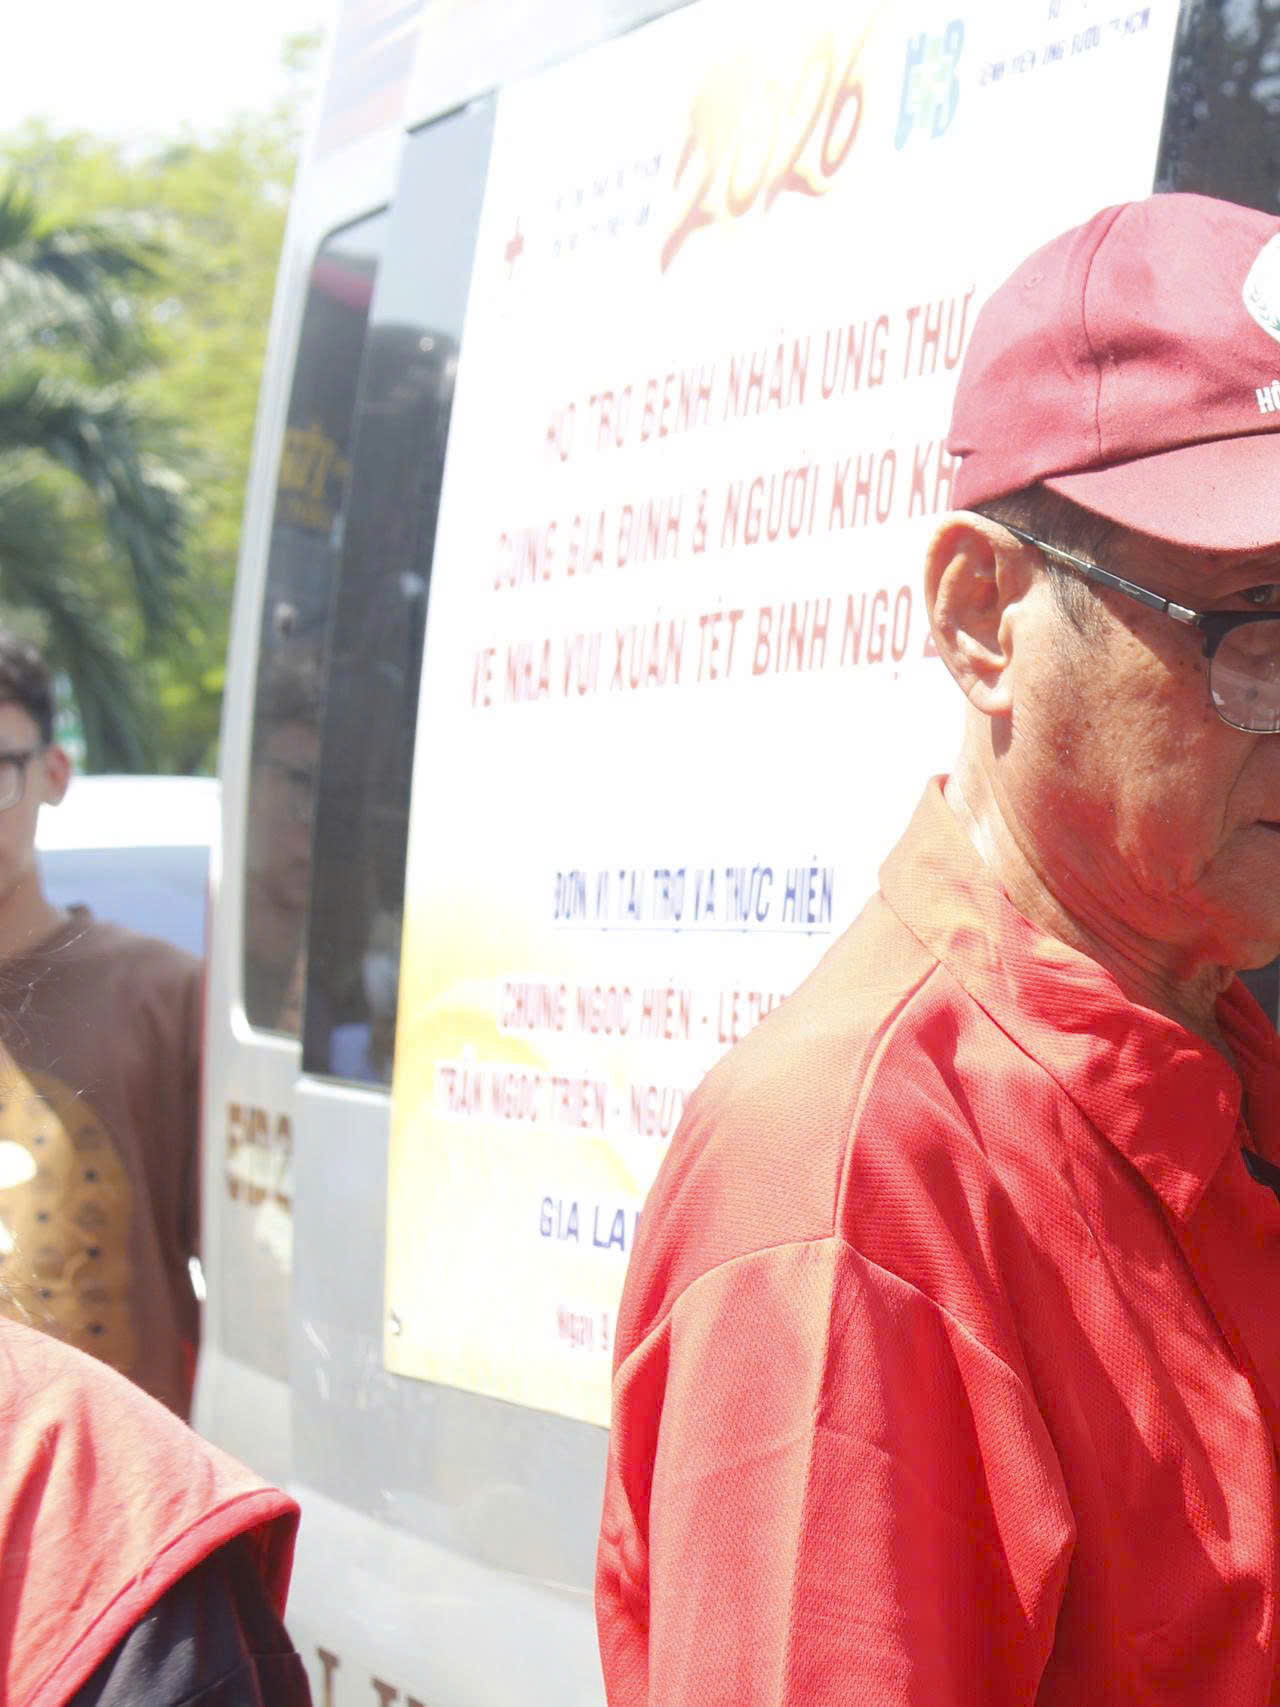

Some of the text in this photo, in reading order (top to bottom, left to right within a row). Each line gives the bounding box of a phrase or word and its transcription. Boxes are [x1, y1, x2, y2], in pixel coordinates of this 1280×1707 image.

[660, 4, 886, 275] 2026
[822, 314, 891, 402] UNG
[903, 282, 978, 380] THƯ
[691, 488, 710, 555] &
[906, 437, 957, 520] KH
[563, 630, 603, 698] VUI
[839, 584, 913, 681] NGỌ
[539, 1195, 580, 1244] GIA
